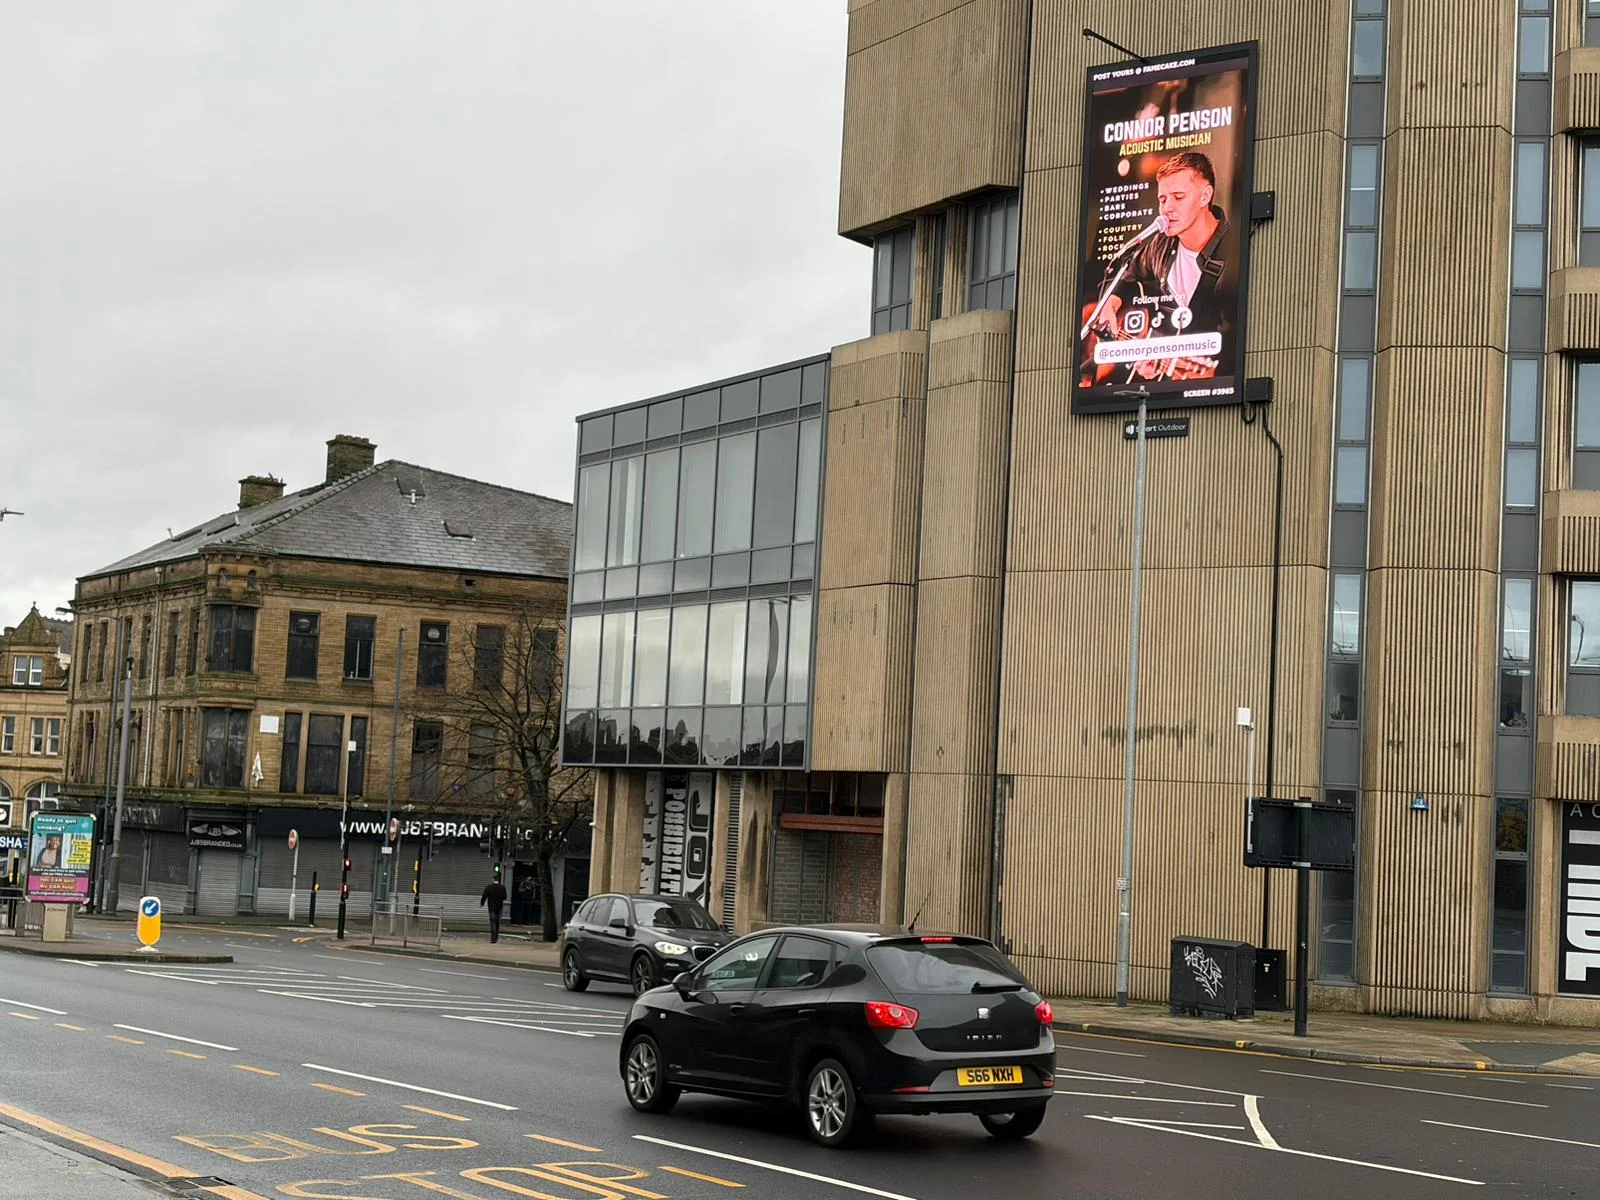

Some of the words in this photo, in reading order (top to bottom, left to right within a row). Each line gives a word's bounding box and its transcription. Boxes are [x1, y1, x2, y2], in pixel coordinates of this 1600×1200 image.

[1093, 73, 1111, 81] POST
[1112, 68, 1134, 78] YOURS
[1143, 58, 1196, 73] FAMECAKE.COM
[1104, 116, 1164, 143] CONNOR
[1169, 106, 1232, 134] PENSON
[1119, 139, 1164, 156] ACOUSTIC
[1165, 132, 1212, 149] MUSICIAN
[1105, 182, 1149, 194] WEDDINGS
[1104, 192, 1139, 203] PARTIES
[1104, 203, 1126, 212] BARS
[1103, 208, 1153, 221] CORPORATE
[1103, 224, 1143, 234] COUNTRY
[1103, 235, 1124, 243] FOLK
[1102, 243, 1125, 252] ROCK
[1132, 295, 1160, 306] Follow
[1100, 339, 1217, 360] @connorpensonmusic
[1183, 389, 1211, 398] SCREEN
[1157, 424, 1186, 432] Outdoor
[967, 1070, 990, 1083] S66
[992, 1068, 1015, 1082] NXH
[174, 1124, 480, 1163] BUS
